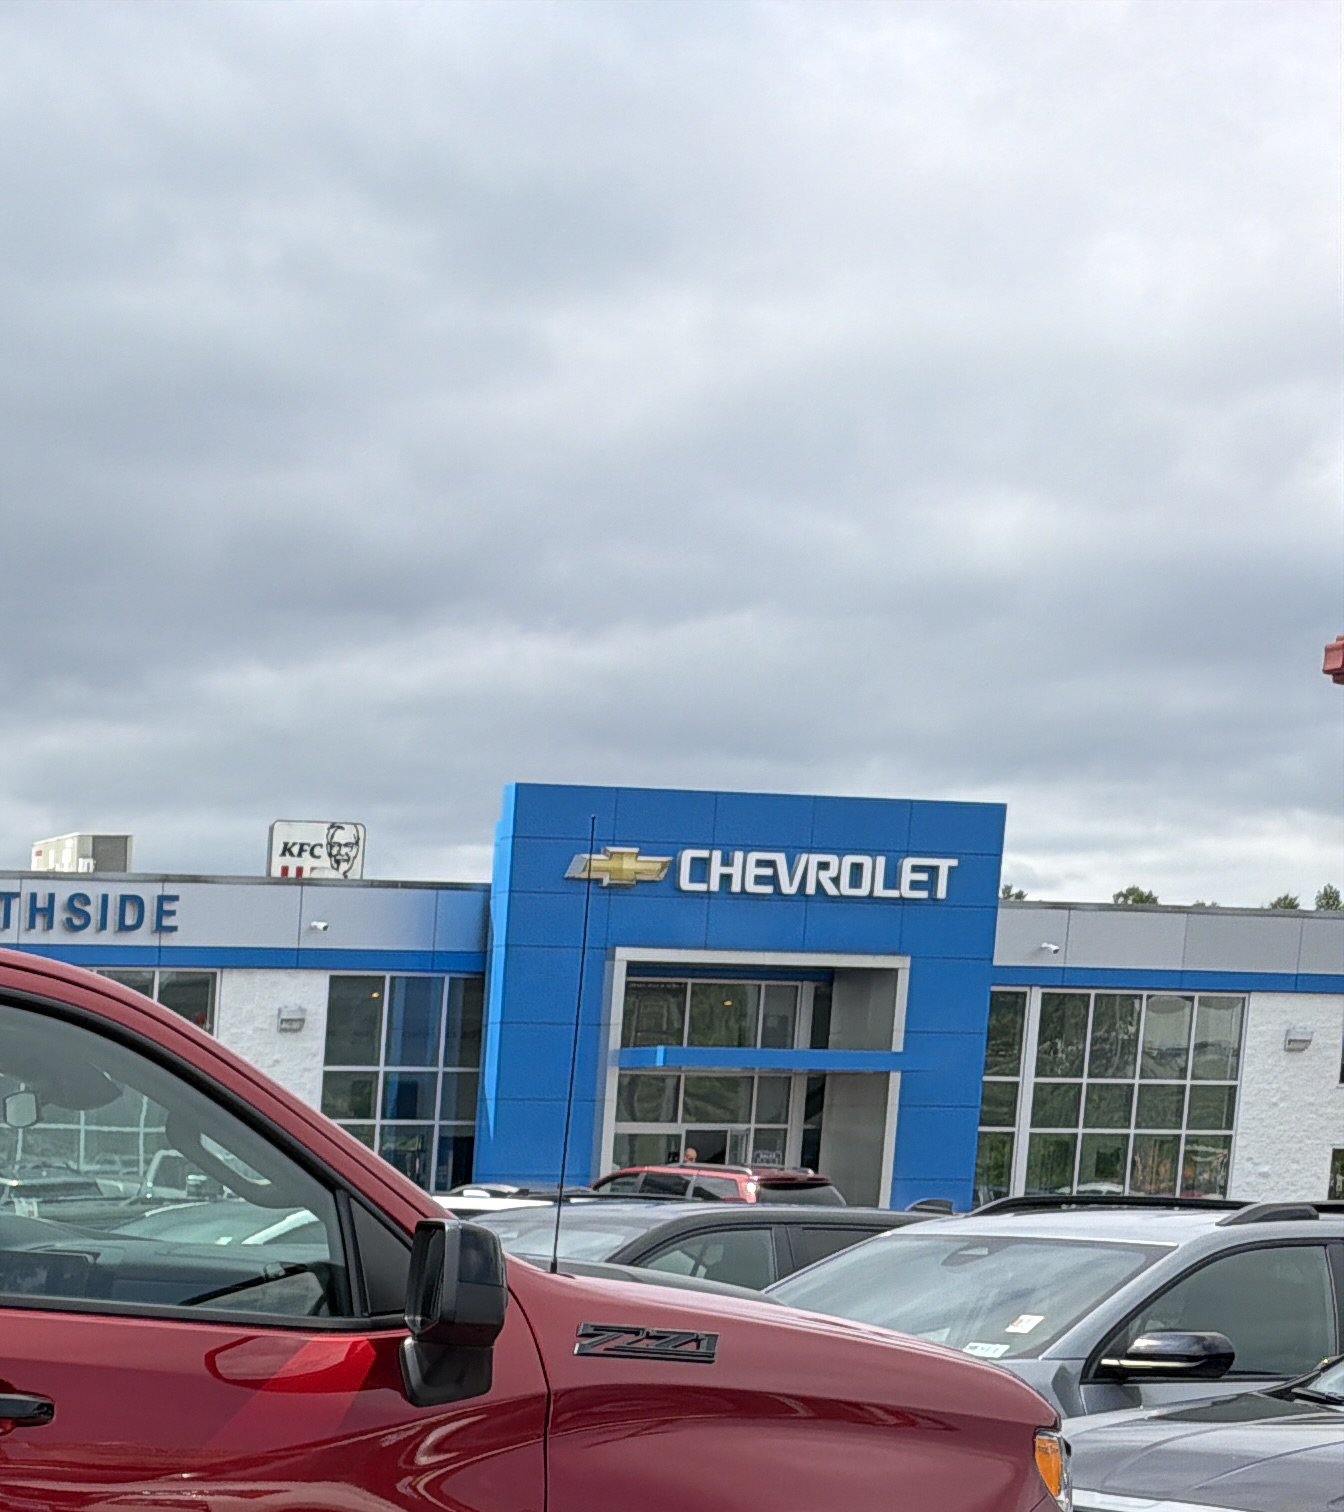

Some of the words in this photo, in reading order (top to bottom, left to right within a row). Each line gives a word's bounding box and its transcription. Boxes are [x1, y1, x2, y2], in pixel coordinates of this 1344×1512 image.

[279, 841, 324, 860] KFC
[679, 849, 959, 900] CHEVROLET
[573, 1322, 720, 1364] Z71
